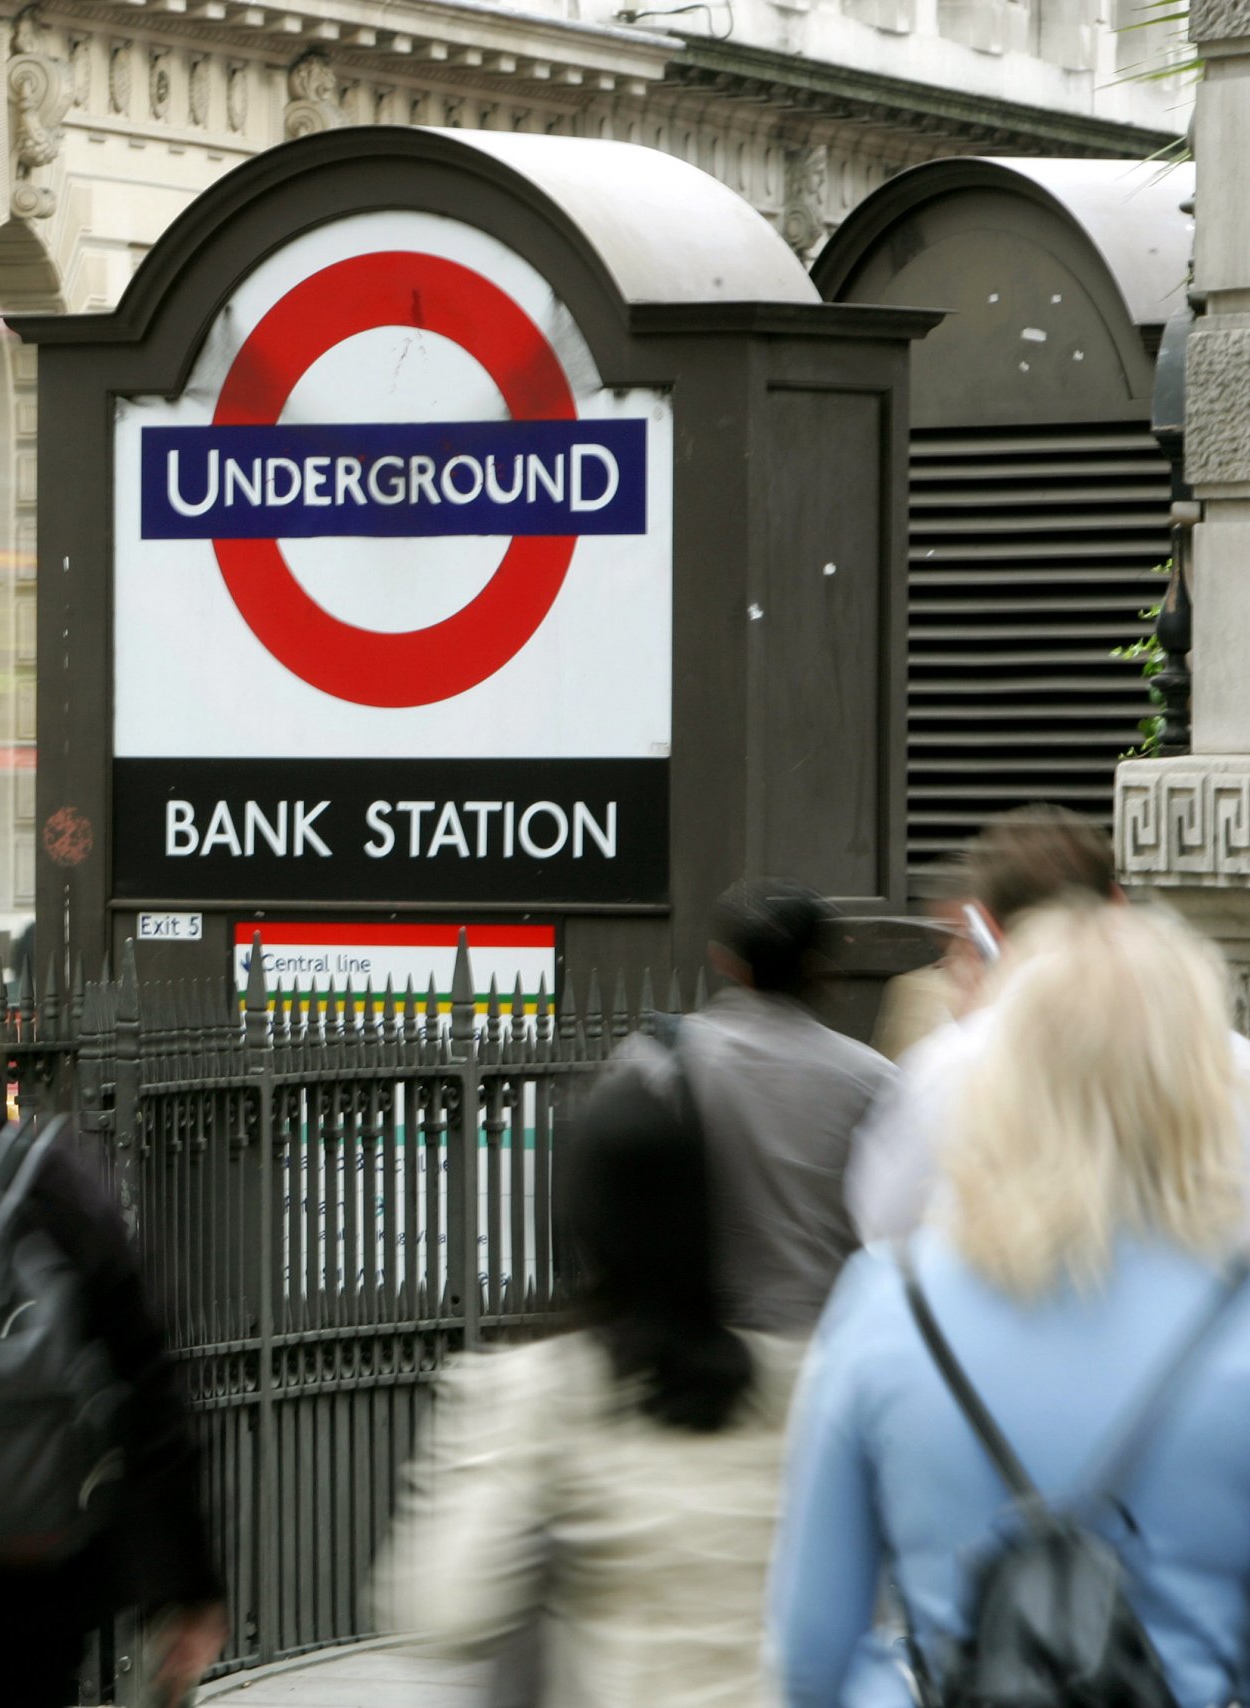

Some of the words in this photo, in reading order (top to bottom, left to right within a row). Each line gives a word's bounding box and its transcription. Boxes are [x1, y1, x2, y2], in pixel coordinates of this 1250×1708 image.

[167, 443, 620, 517] UNDERGROUND
[165, 799, 334, 858] BANK
[363, 799, 618, 859] STATION
[141, 915, 180, 935] Exit
[188, 915, 200, 935] 5
[263, 952, 329, 972] Central
[337, 953, 371, 973] line
